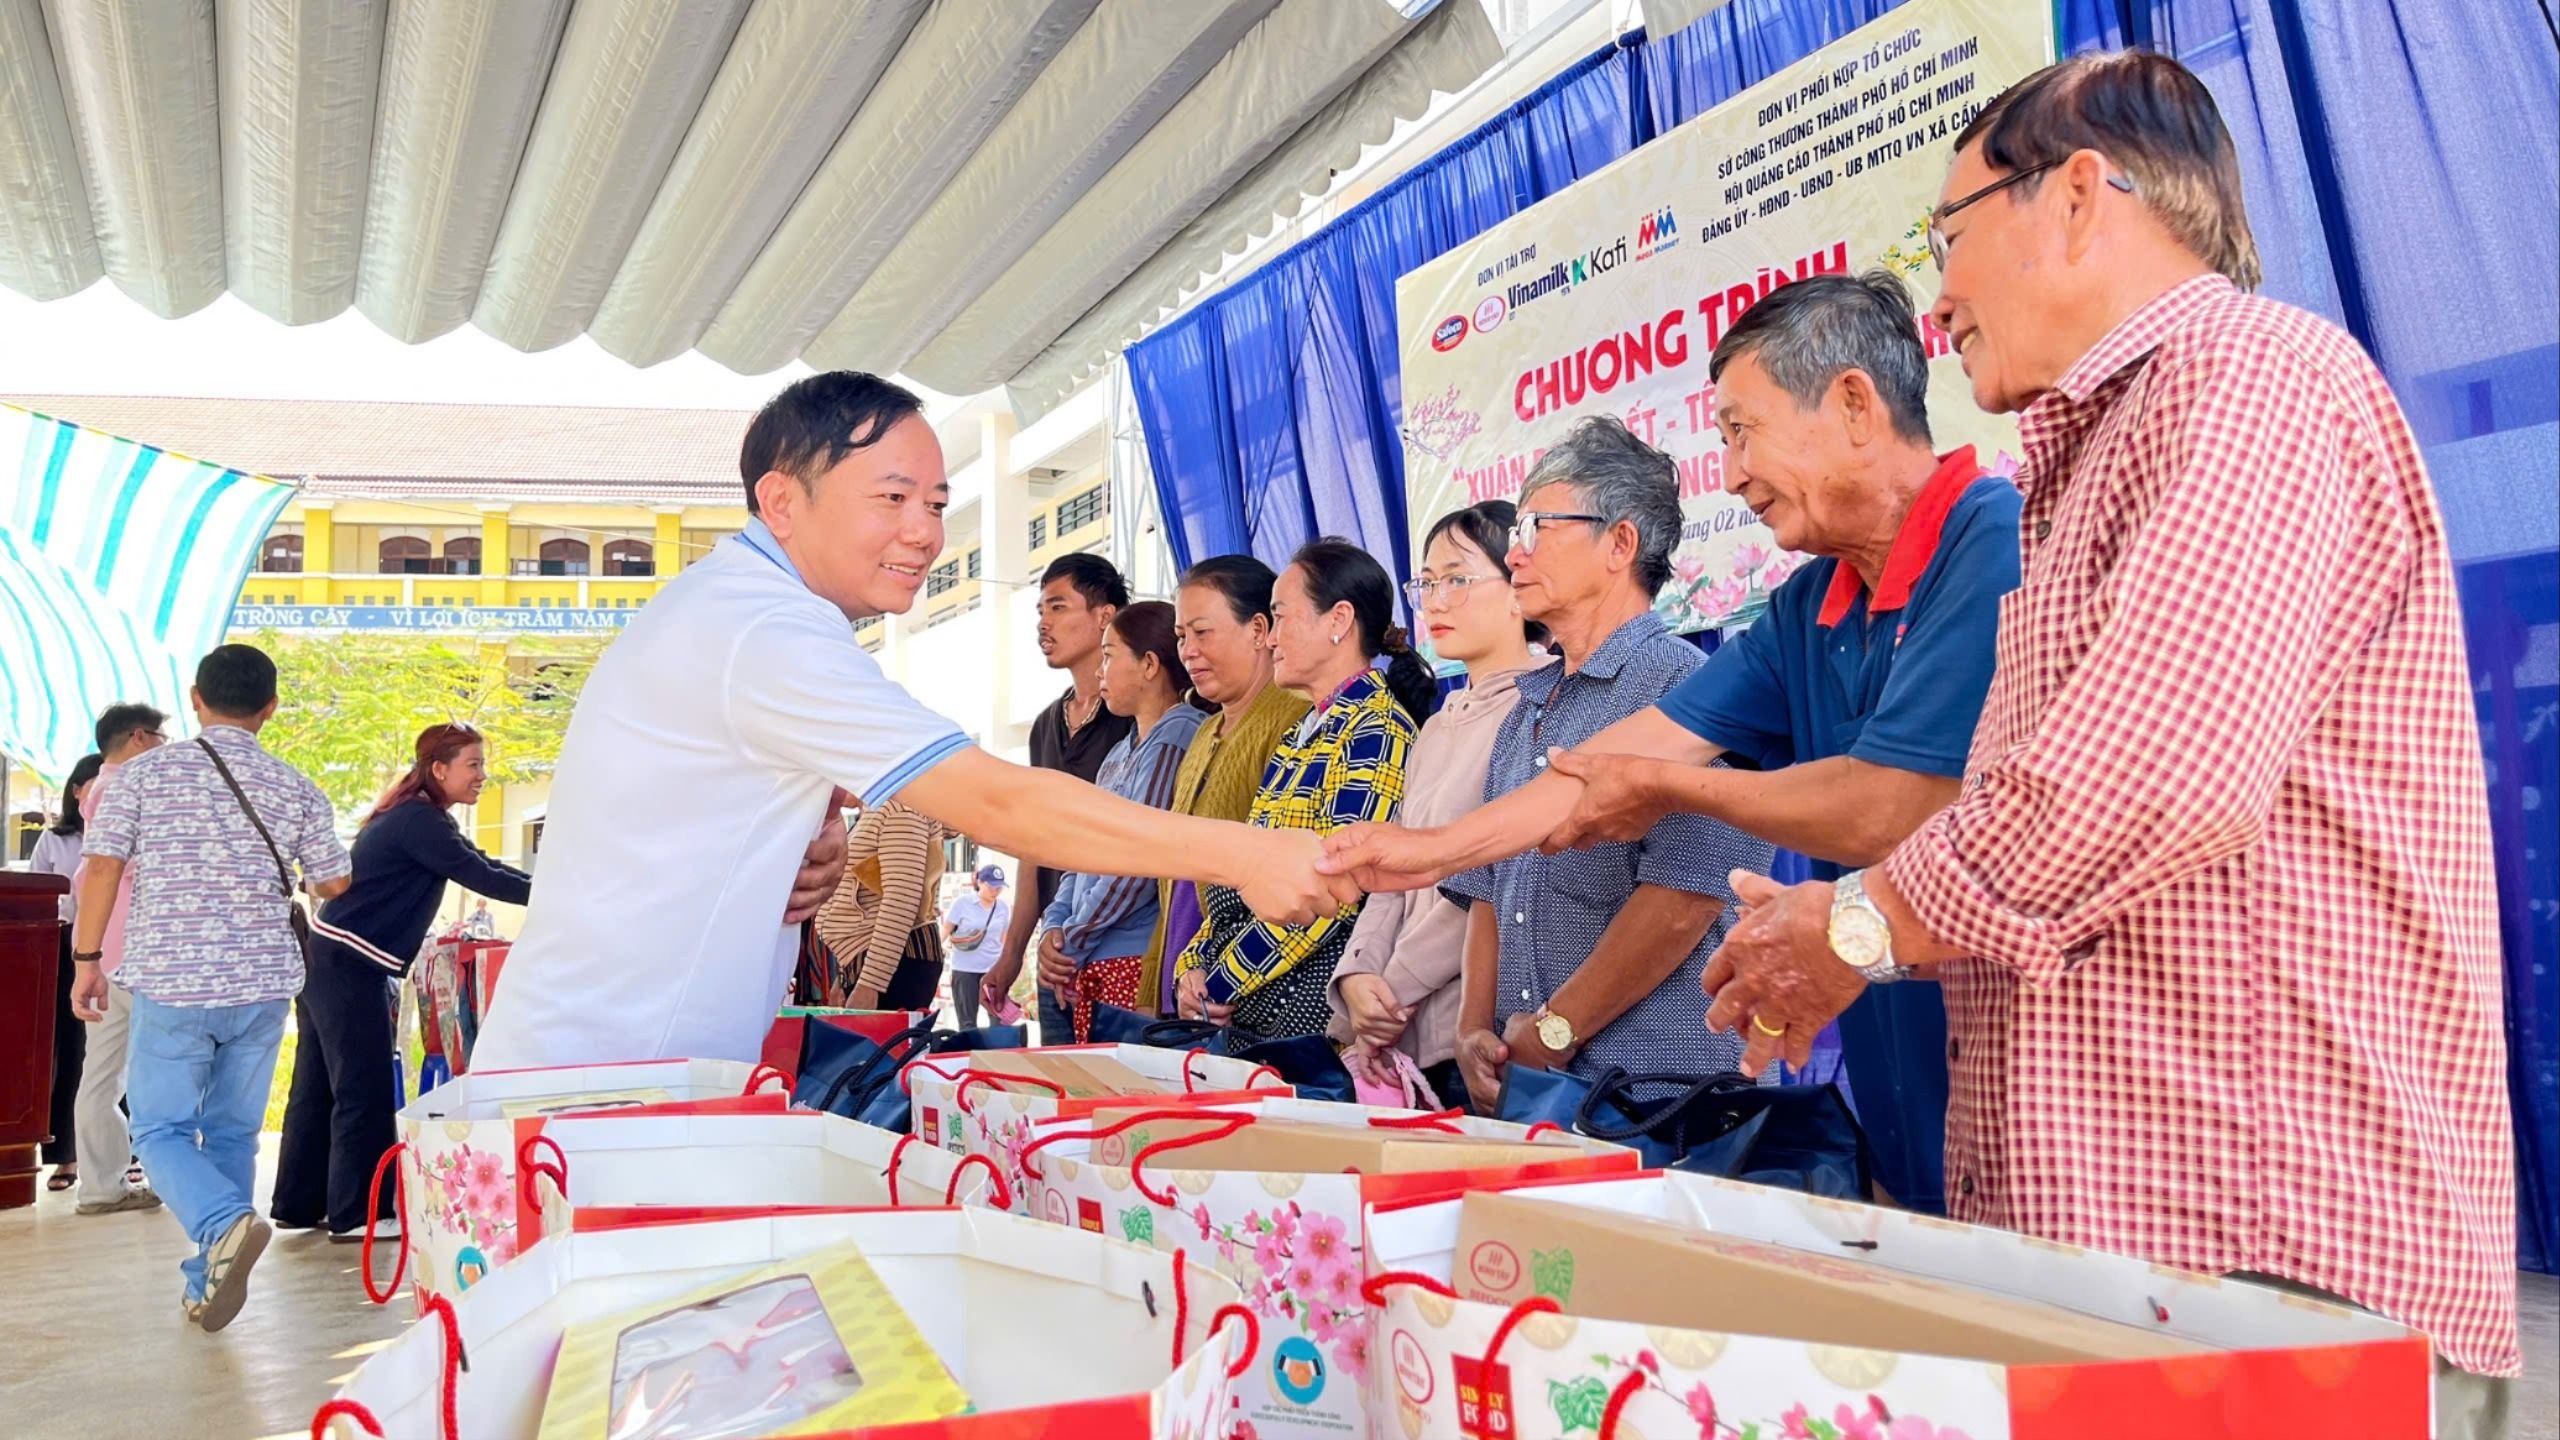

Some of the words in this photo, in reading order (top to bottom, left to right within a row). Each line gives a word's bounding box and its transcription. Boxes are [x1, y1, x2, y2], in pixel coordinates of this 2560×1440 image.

[1758, 102, 1783, 127] ĐƠN
[1786, 92, 1798, 114] VỊ
[1801, 71, 1829, 106] PHỐI
[1833, 62, 1859, 88] HỢP
[1863, 42, 1880, 73] TỔ
[1884, 28, 1922, 62] CHỨC
[1718, 153, 1733, 180] SỞ
[1736, 143, 1766, 171] CÔNG
[1768, 118, 1814, 155] THƯƠNG
[1816, 97, 1858, 130] THÀNH
[1862, 75, 1887, 109] PHỐ
[1891, 65, 1909, 96] HỒ
[1914, 54, 1936, 84] CHÍ
[1940, 37, 1978, 72] MINH
[1725, 181, 1743, 205] HỘI
[1746, 163, 1784, 196] QUẢNG
[1787, 150, 1810, 175] CÁO
[1813, 130, 1854, 163] THÀNH
[1857, 109, 1884, 142] PHỐ
[1888, 99, 1906, 129] HỒ
[1909, 87, 1932, 118] CHÍ
[1936, 72, 1974, 106] MINH
[1702, 217, 1732, 243] ĐẢNG
[1735, 207, 1748, 229] ỦY
[1759, 190, 1790, 218] HĐND
[1801, 169, 1833, 199] UBND
[1845, 156, 1863, 178] UB
[1867, 138, 1902, 170] MTTQ
[1906, 128, 1925, 151] VN
[1928, 115, 1947, 143] XÃ
[1496, 261, 1504, 278] VỊ
[1505, 253, 1518, 272] TÀI
[1520, 243, 1537, 263] TRỢ
[1590, 236, 1627, 278] Kafi
[1508, 261, 1570, 310] Vinamilk
[1513, 309, 1688, 423] CHƯƠNG
[1714, 507, 1735, 533] 02
[234, 606, 304, 625] TRỒNG
[310, 606, 352, 626] CÂY
[389, 604, 412, 625] VÌ
[420, 608, 450, 629] LỢI
[1460, 1384, 1504, 1409] SIMLY
[1463, 1400, 1507, 1431] FOD
